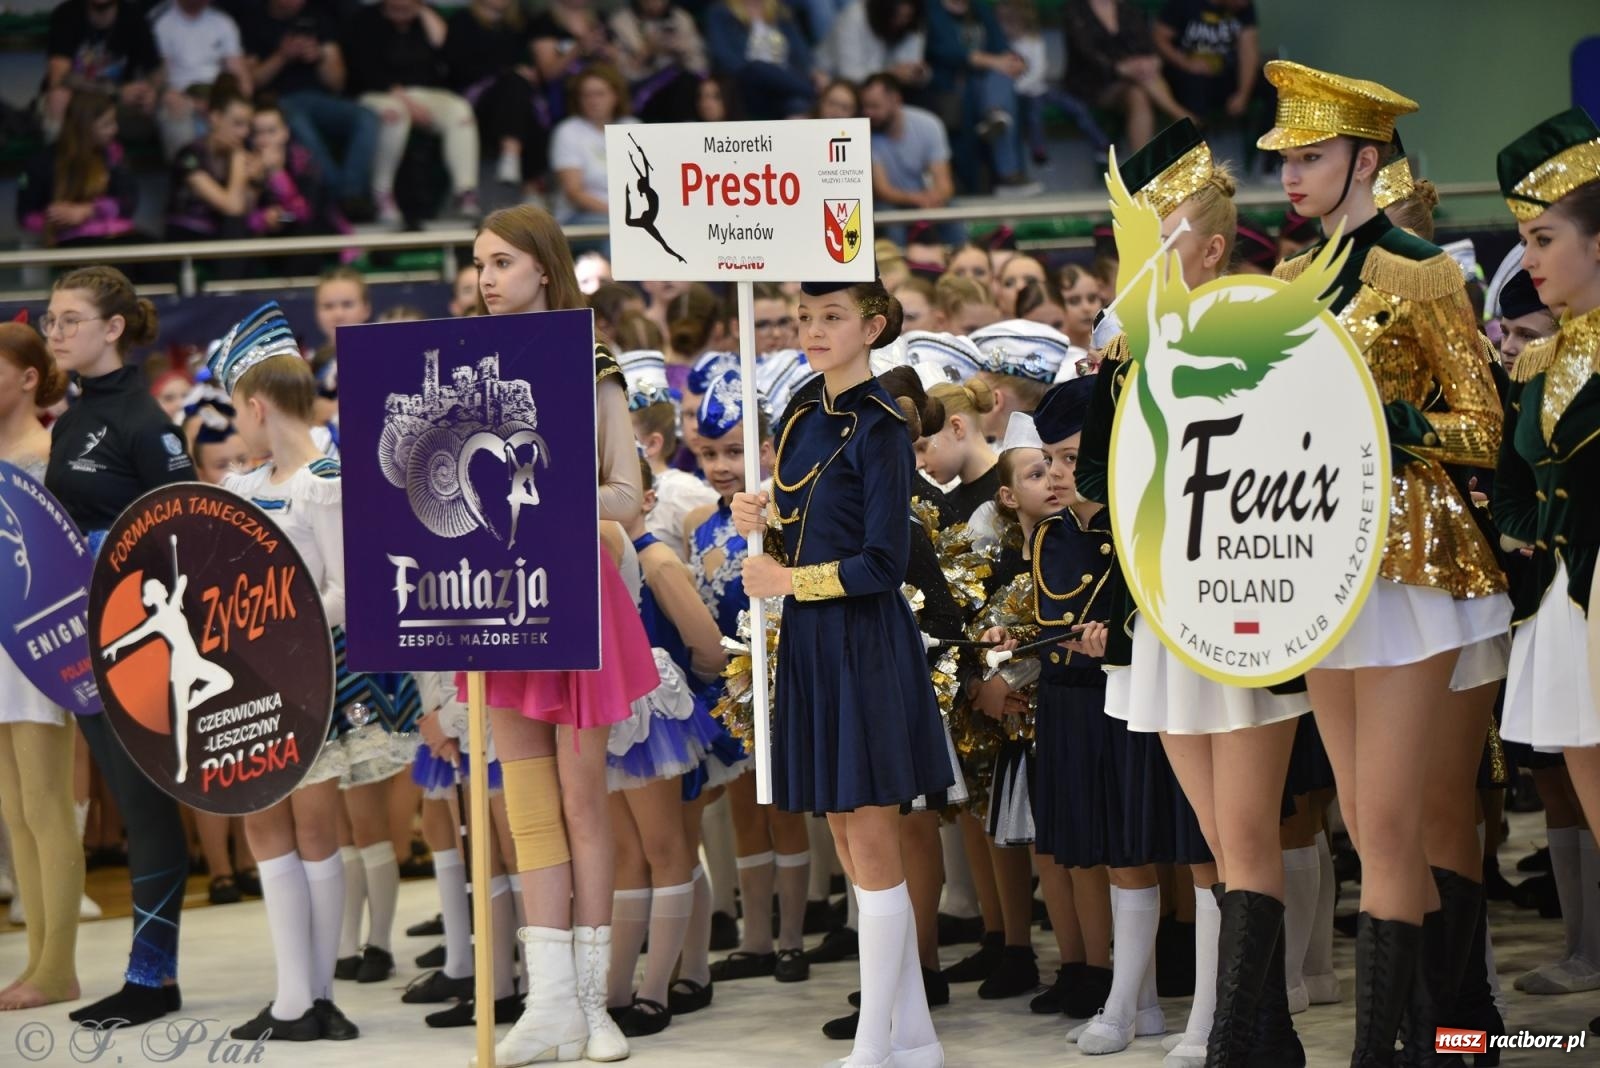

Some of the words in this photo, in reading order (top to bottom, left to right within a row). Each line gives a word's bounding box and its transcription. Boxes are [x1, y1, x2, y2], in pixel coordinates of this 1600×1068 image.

[704, 135, 773, 154] Mażoretki
[681, 163, 801, 206] Presto
[708, 223, 774, 244] Mykanów
[717, 256, 765, 270] POLAND
[1180, 413, 1340, 562] Fenix
[109, 497, 183, 573] FORMACJA
[187, 495, 279, 555] TANECZNA
[1216, 534, 1314, 560] RADLIN
[386, 552, 550, 627] Fantazja
[1197, 579, 1295, 604] POLAND
[398, 631, 454, 647] ZESPÓŁ
[459, 629, 548, 646] MAŻORETEK
[1178, 622, 1272, 668] TANECZNY
[1284, 613, 1330, 658] KLUB
[197, 692, 283, 734] CZERWIONKA
[203, 713, 281, 753] -LESZCZYNY
[201, 732, 300, 792] POLSKA
